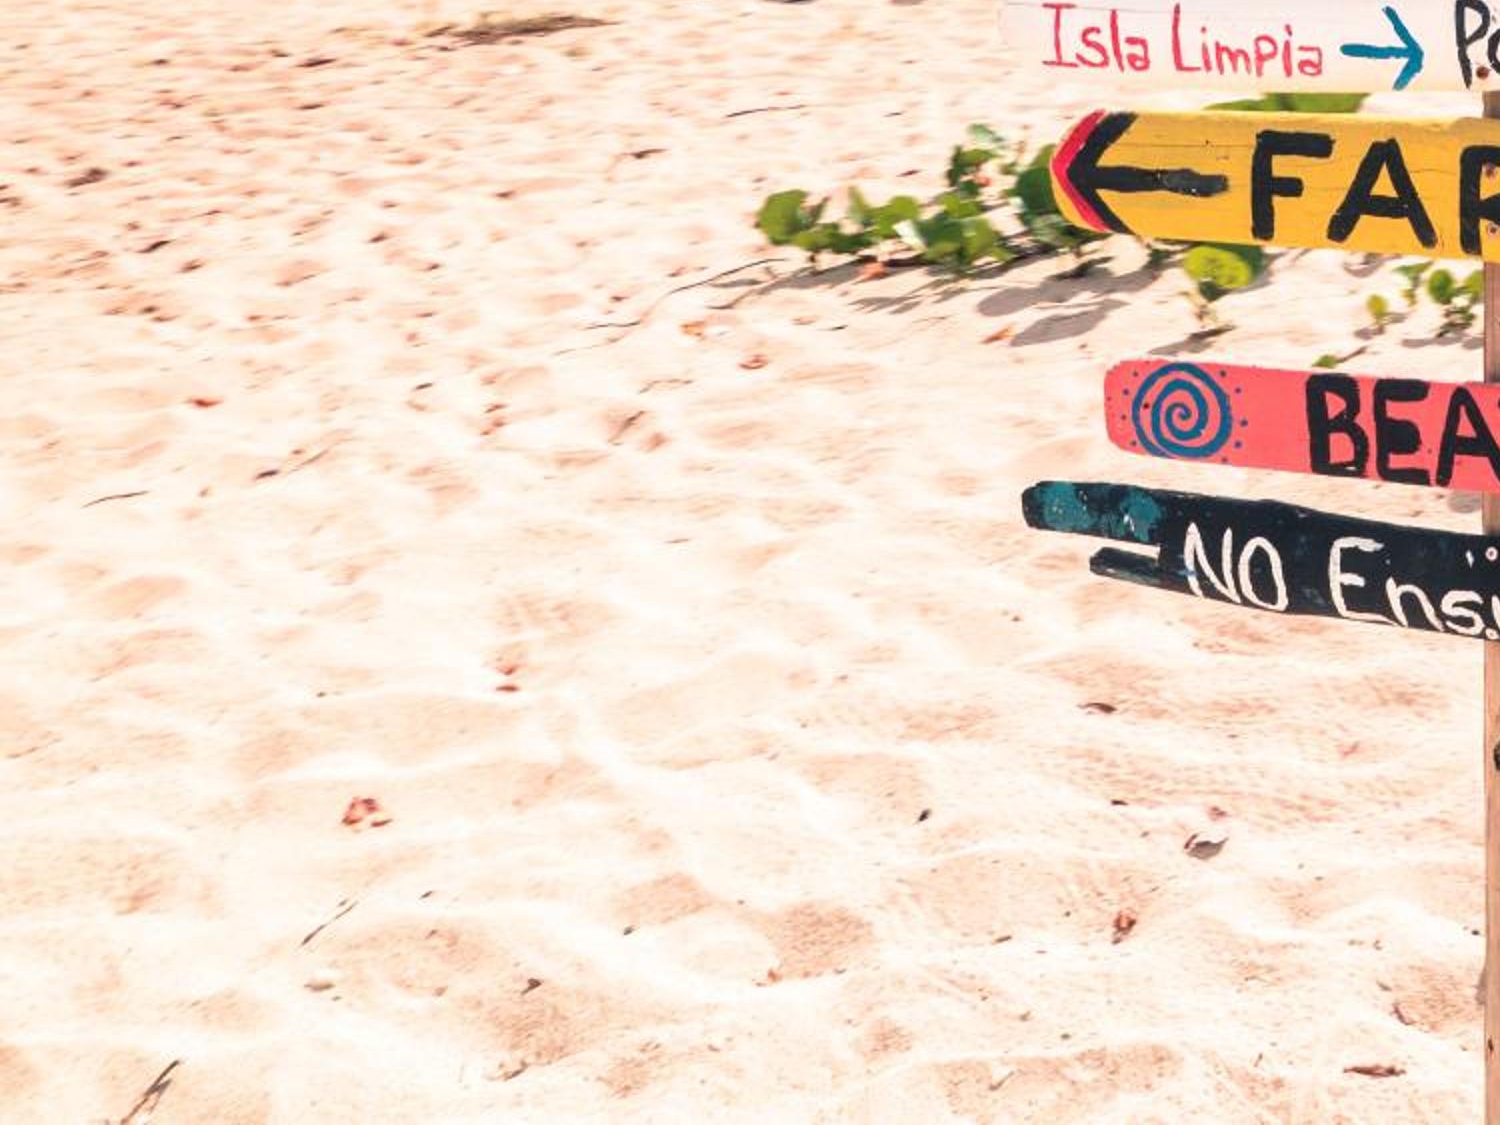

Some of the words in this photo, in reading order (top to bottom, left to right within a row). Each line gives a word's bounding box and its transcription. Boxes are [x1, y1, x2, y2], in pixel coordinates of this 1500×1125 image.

[1041, 2, 1151, 73] Isla
[1170, 3, 1324, 77] Limpia
[1184, 522, 1288, 613] NO
